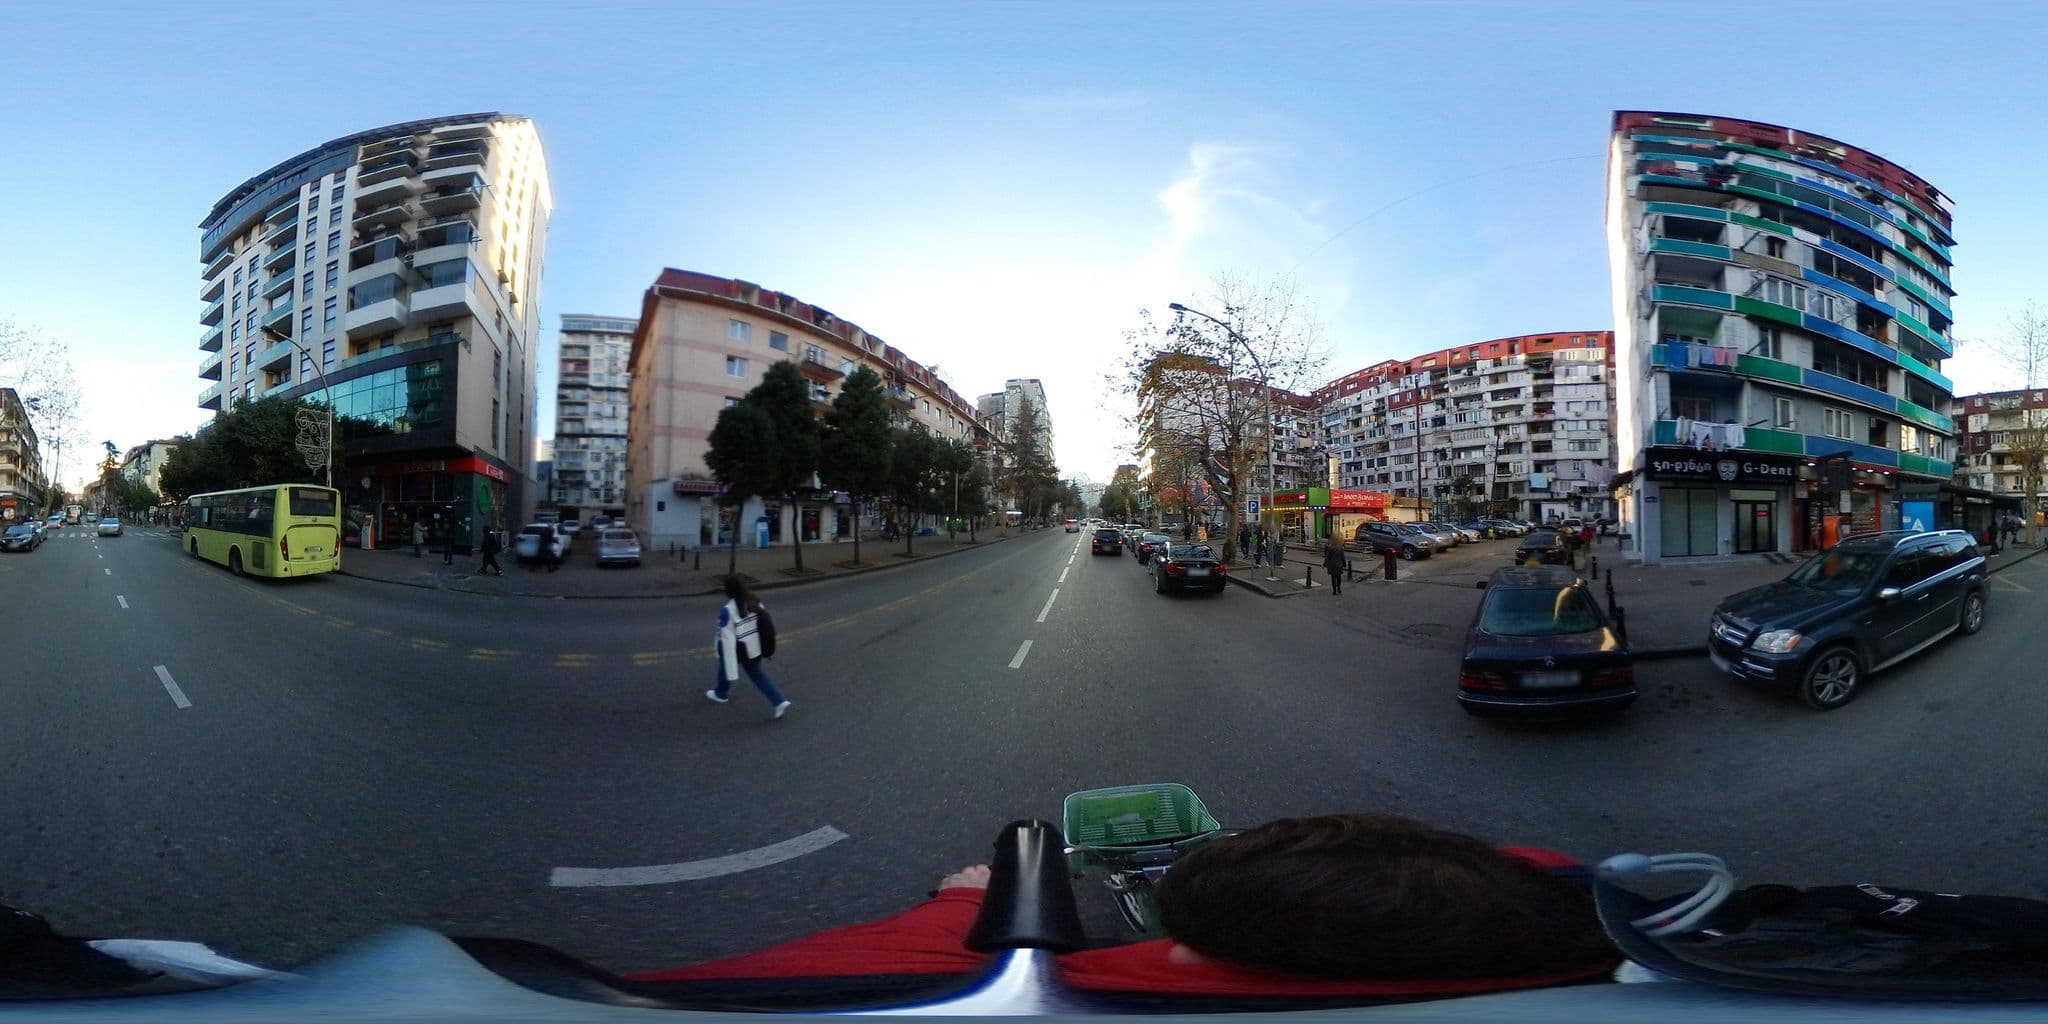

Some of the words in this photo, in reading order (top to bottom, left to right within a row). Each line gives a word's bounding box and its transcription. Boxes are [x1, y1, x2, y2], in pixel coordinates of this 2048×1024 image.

[1652, 458, 1712, 472] ჯი-დენტი
[1743, 462, 1792, 476] G-Dent
[1250, 502, 1256, 512] P
